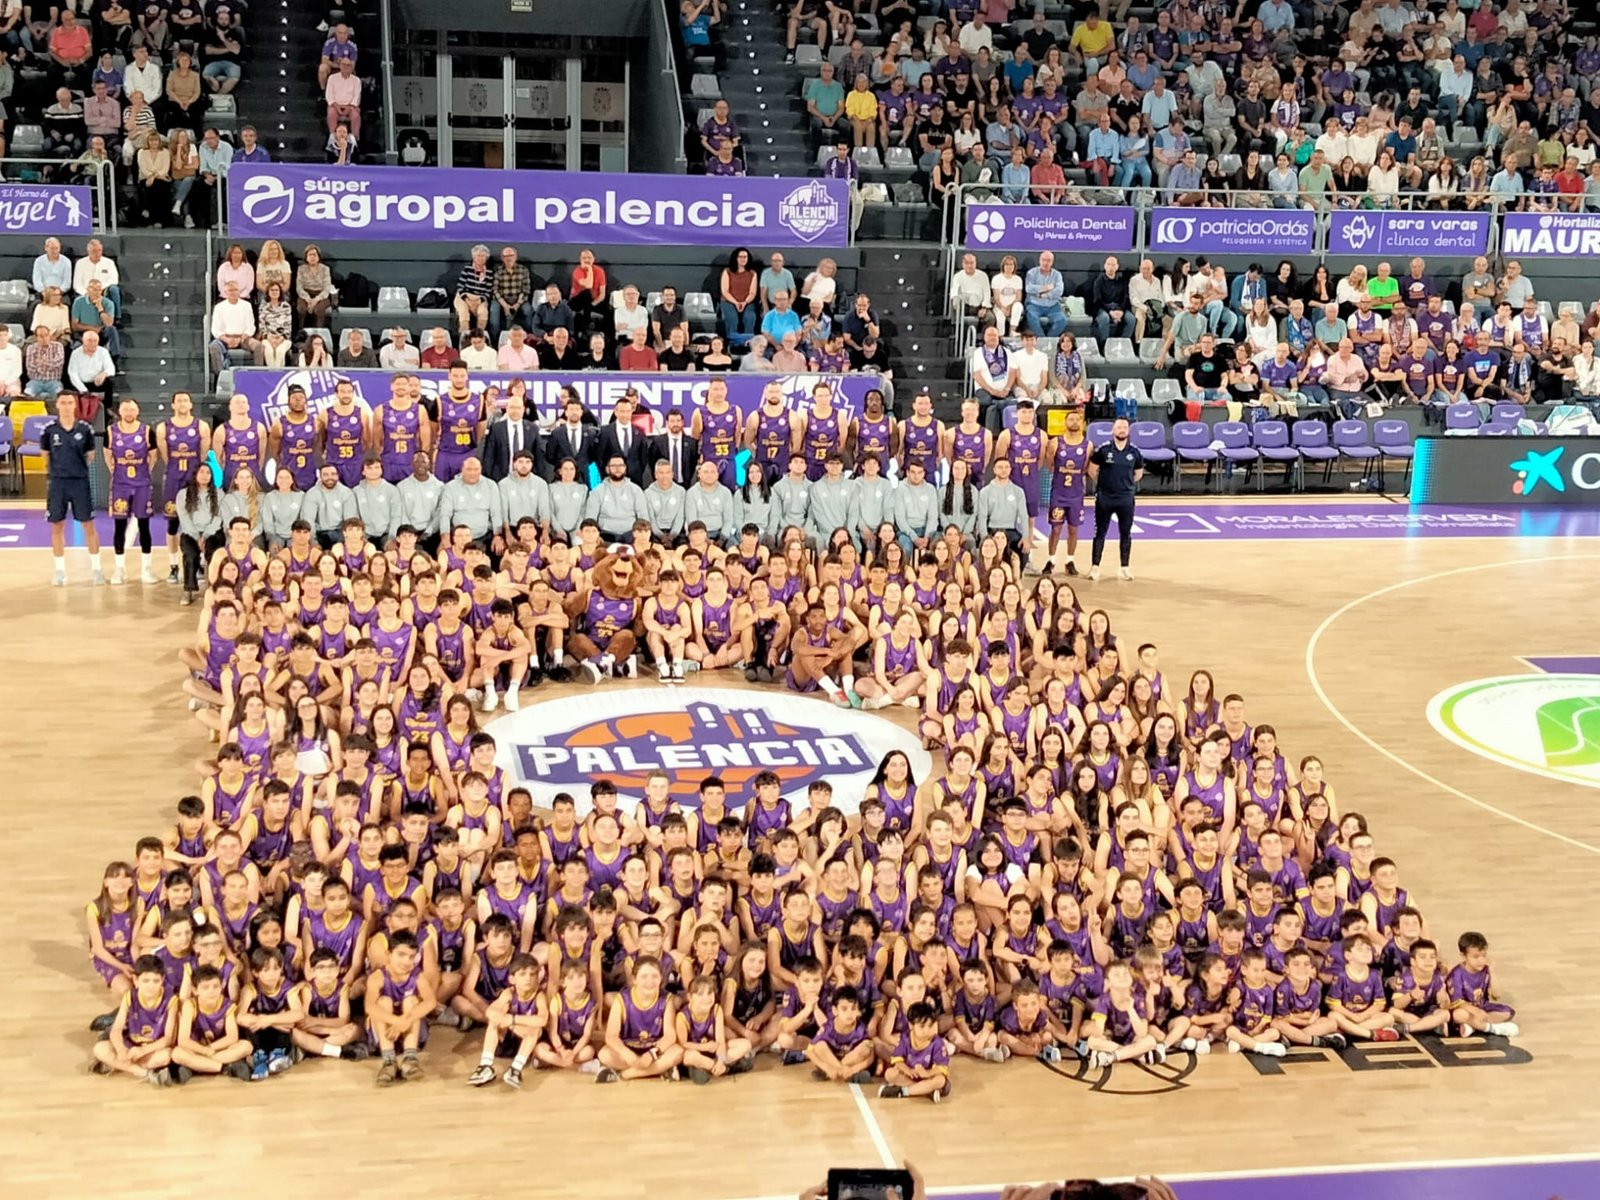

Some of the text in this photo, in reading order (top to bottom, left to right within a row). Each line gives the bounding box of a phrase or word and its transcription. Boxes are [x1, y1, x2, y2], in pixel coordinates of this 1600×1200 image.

[304, 176, 370, 194] súper
[1, 188, 49, 198] El Horno de
[304, 188, 514, 229] agropal
[535, 191, 766, 230] palencia
[782, 204, 836, 221] PALENCIA
[1014, 216, 1127, 230] Policlínica Dental
[1200, 218, 1309, 237] patriciaOrdás
[1388, 219, 1478, 231] sara varas
[1034, 231, 1044, 241] by
[1045, 231, 1066, 240] Pérez
[1076, 232, 1102, 241] Arroyo
[1222, 237, 1265, 245] PELUQUERÍA
[1274, 238, 1307, 246] ESTÉTICA
[1386, 231, 1475, 247] clínica dental
[339, 446, 354, 458] 35
[715, 444, 729, 456] 33
[767, 447, 778, 459] 17
[1064, 475, 1072, 486] 2
[528, 738, 863, 776] PALENCIA
